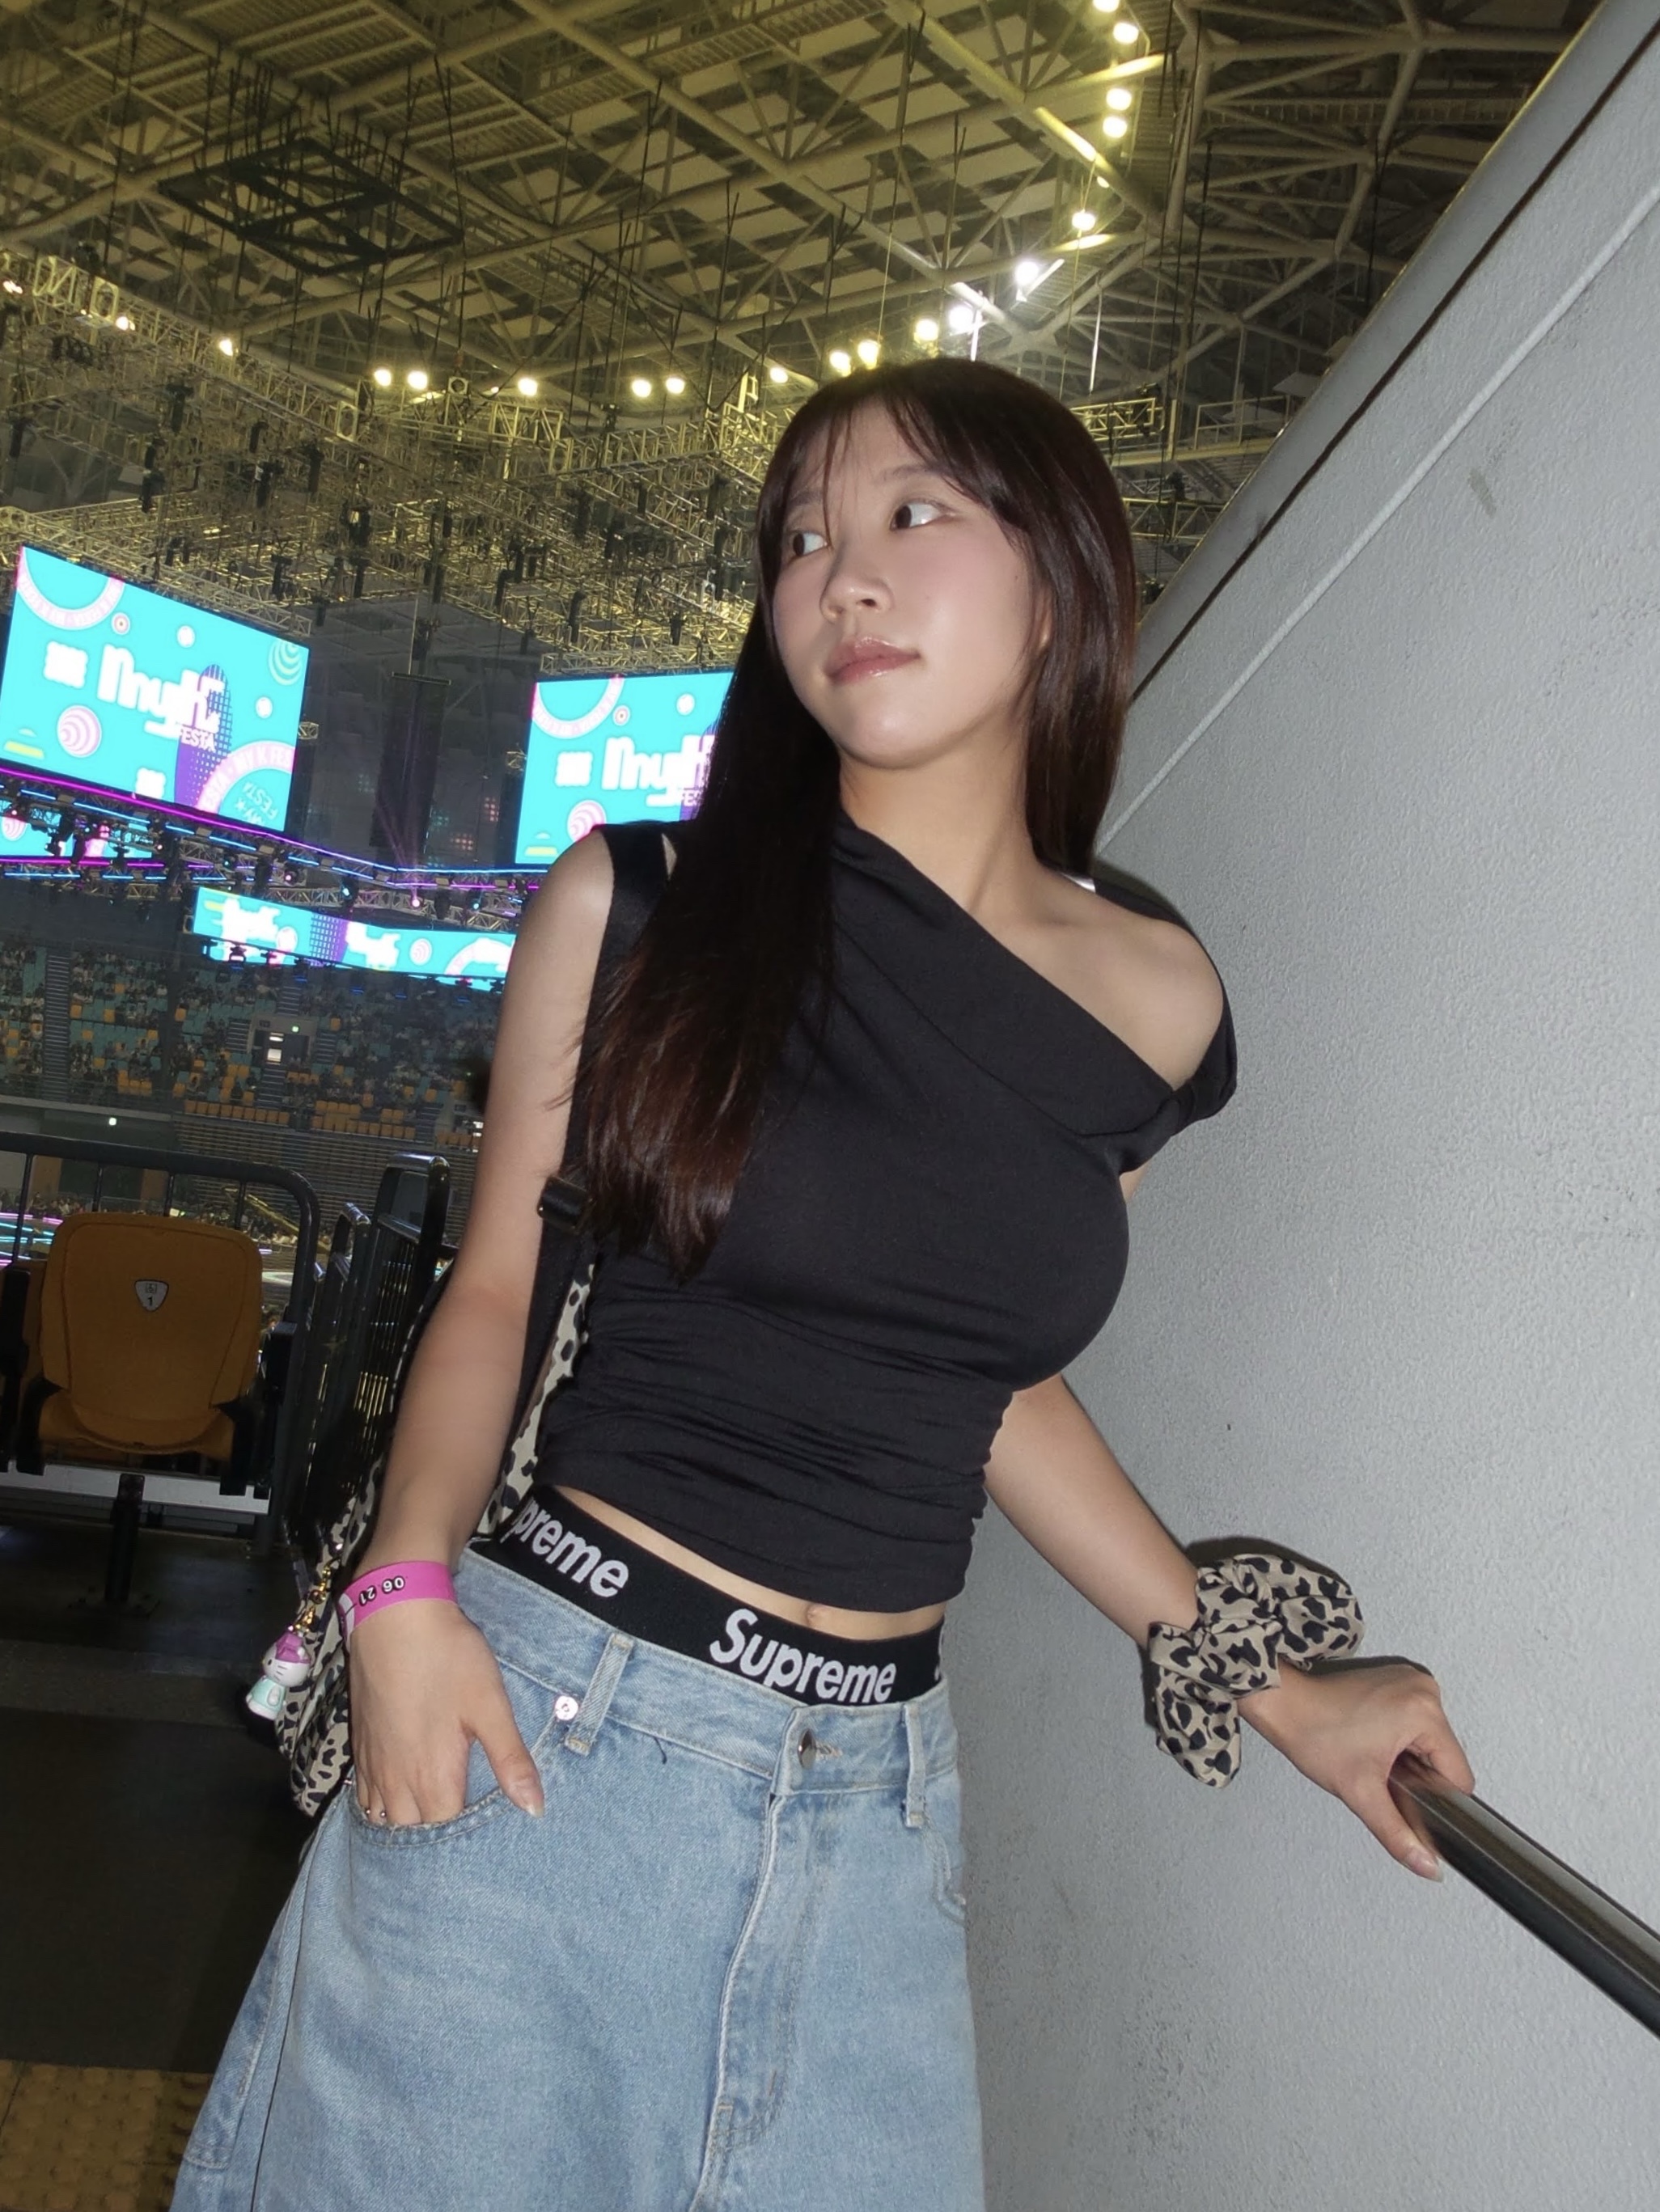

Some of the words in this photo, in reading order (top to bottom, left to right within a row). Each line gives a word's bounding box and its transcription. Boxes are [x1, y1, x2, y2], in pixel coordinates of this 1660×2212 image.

[500, 1496, 629, 1597] preme
[358, 1585, 377, 1606] 21
[382, 1575, 405, 1594] 06
[709, 1609, 896, 1704] Supreme
